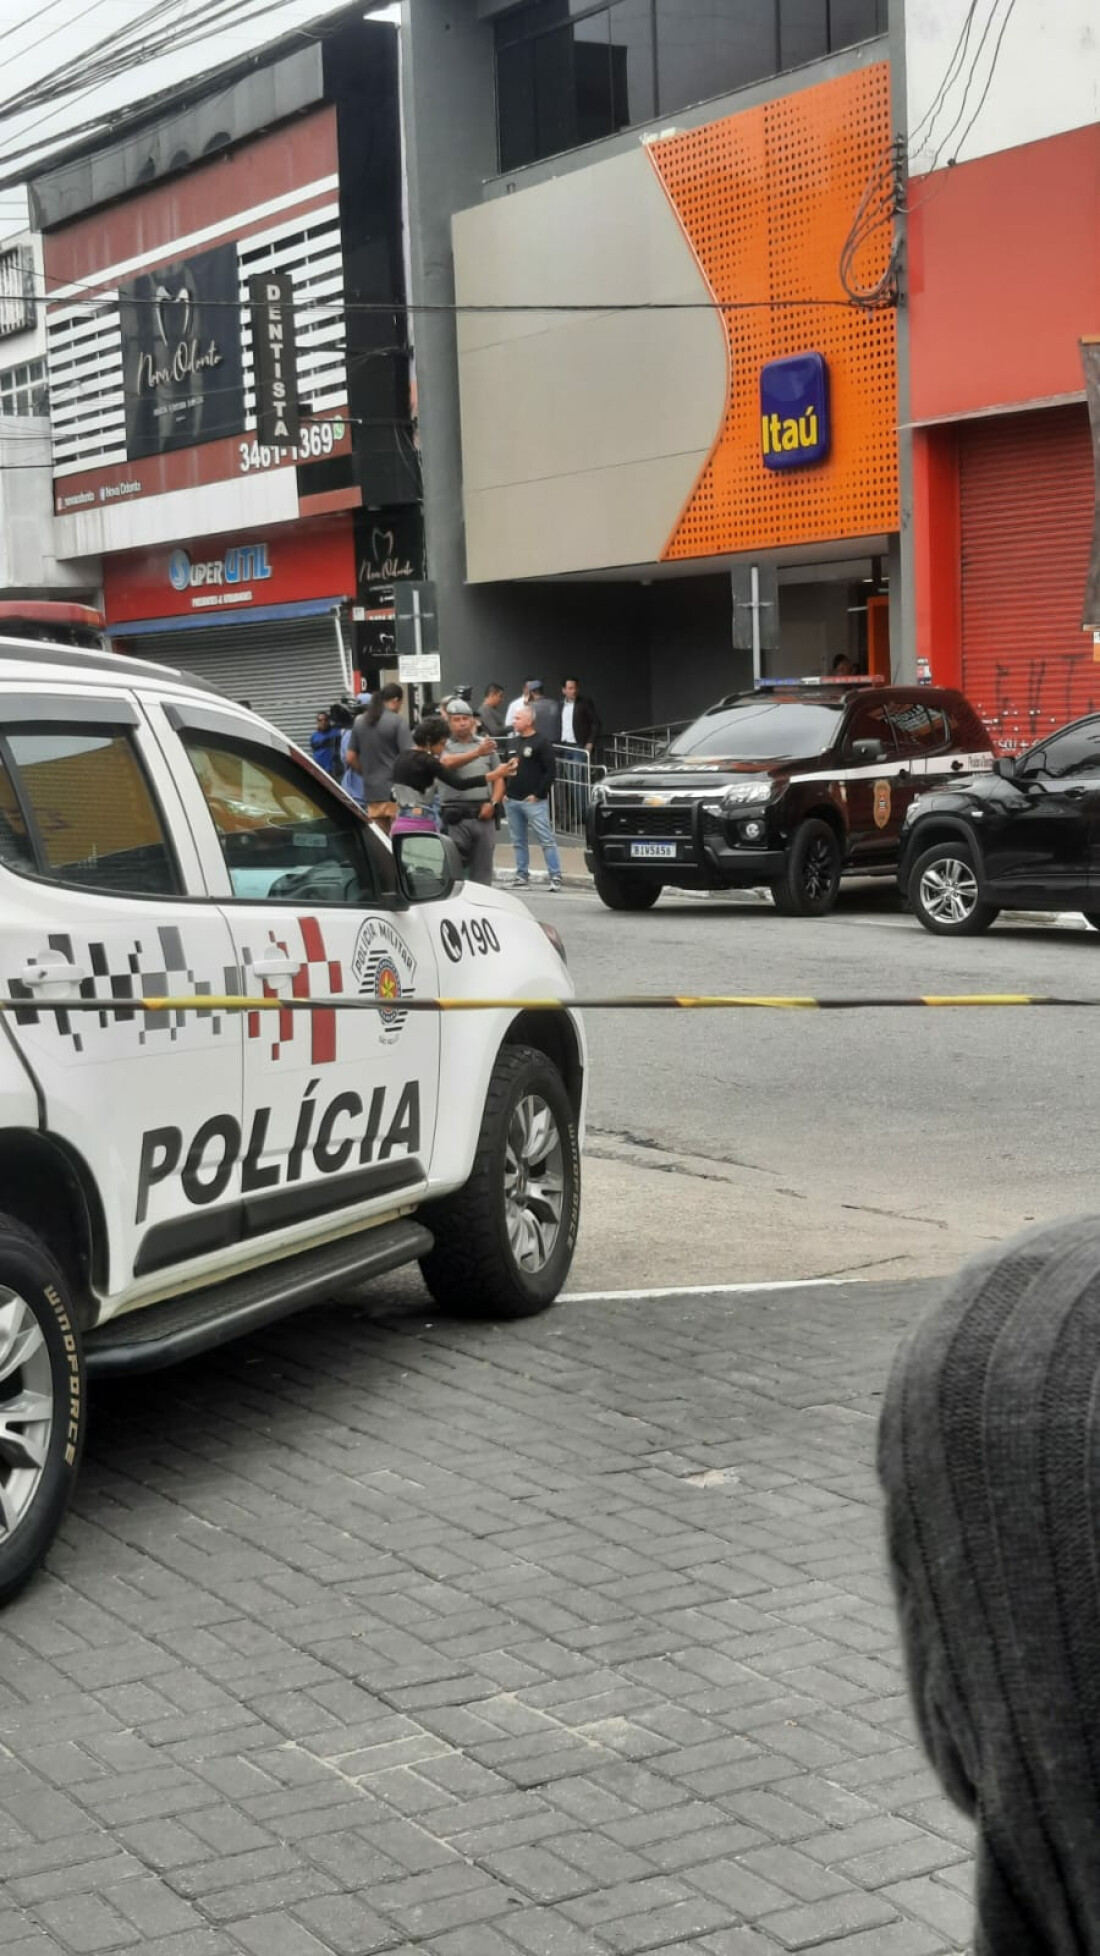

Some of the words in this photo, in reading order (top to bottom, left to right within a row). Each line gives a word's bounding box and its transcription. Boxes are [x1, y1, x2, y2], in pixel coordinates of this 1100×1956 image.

[266, 284, 289, 437] DENTISTA
[762, 405, 818, 455] Itaú
[378, 922, 413, 970] MILITAR
[461, 917, 502, 957] 190
[135, 1078, 421, 1226] POLÍCIA
